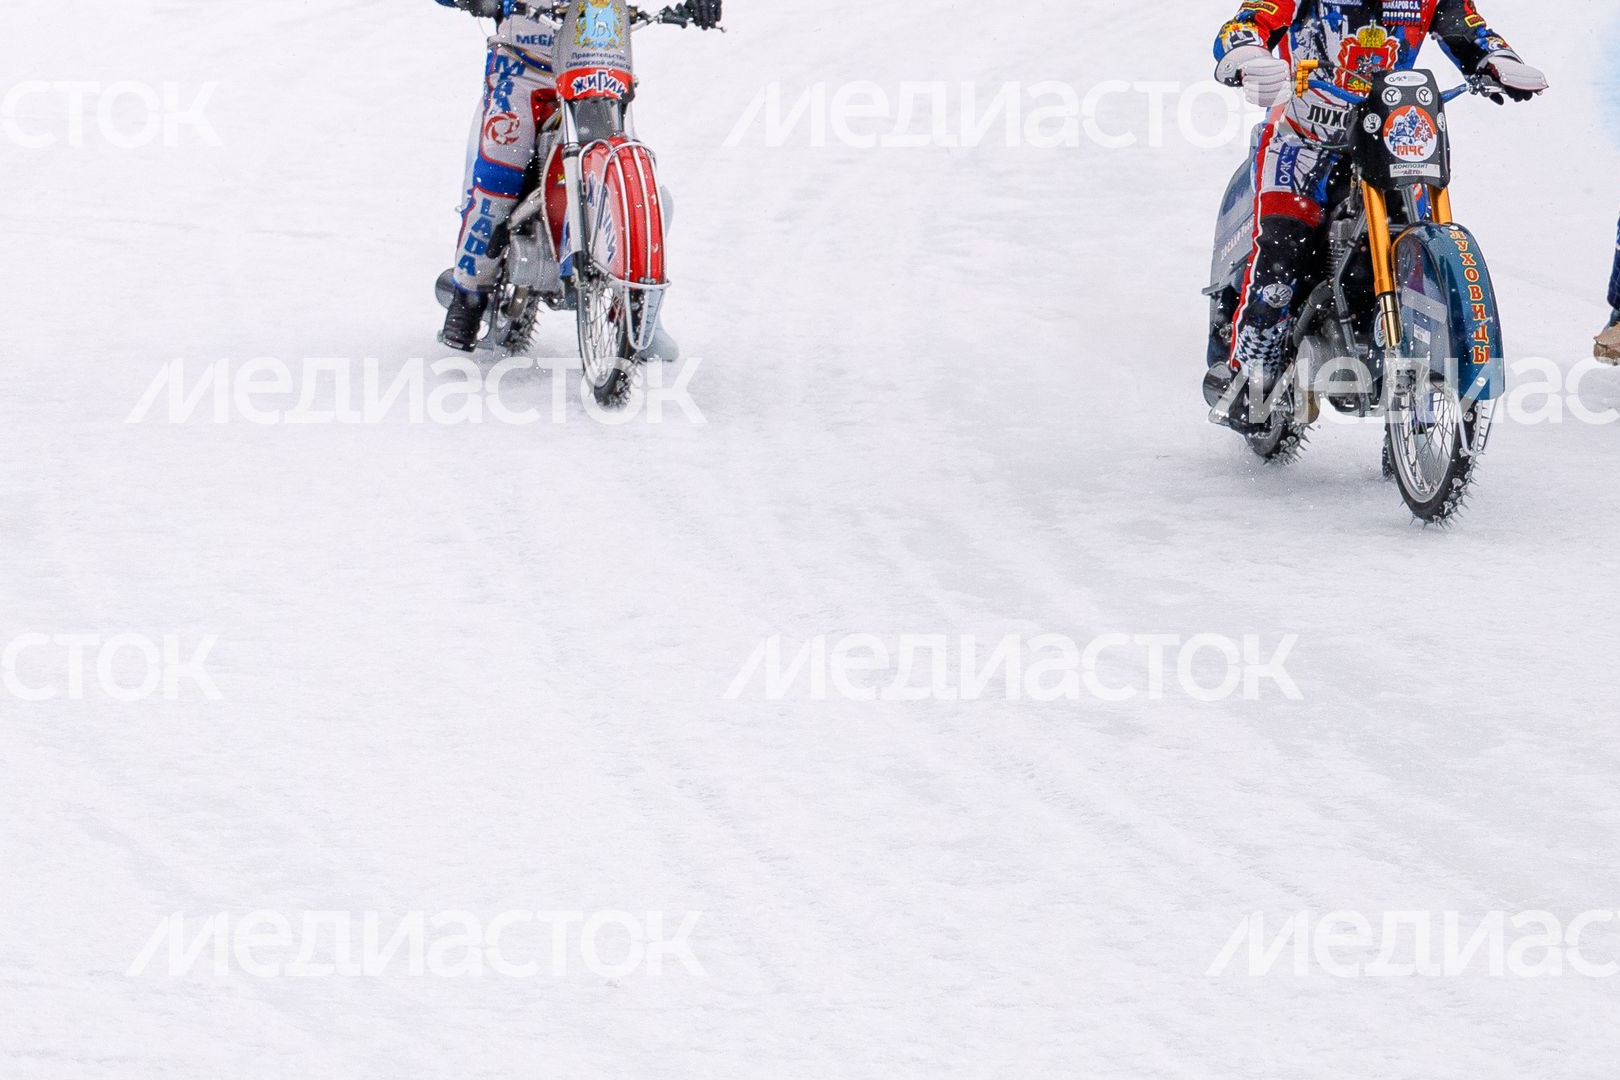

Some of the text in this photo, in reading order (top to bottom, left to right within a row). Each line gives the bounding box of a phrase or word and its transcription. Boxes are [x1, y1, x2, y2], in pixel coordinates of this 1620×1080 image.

[1382, 11, 1421, 26] RUSSIA
[1396, 144, 1425, 157] МЧС
[457, 197, 497, 277] LADA
[1448, 229, 1492, 365] ЛУХОВИЦЫ
